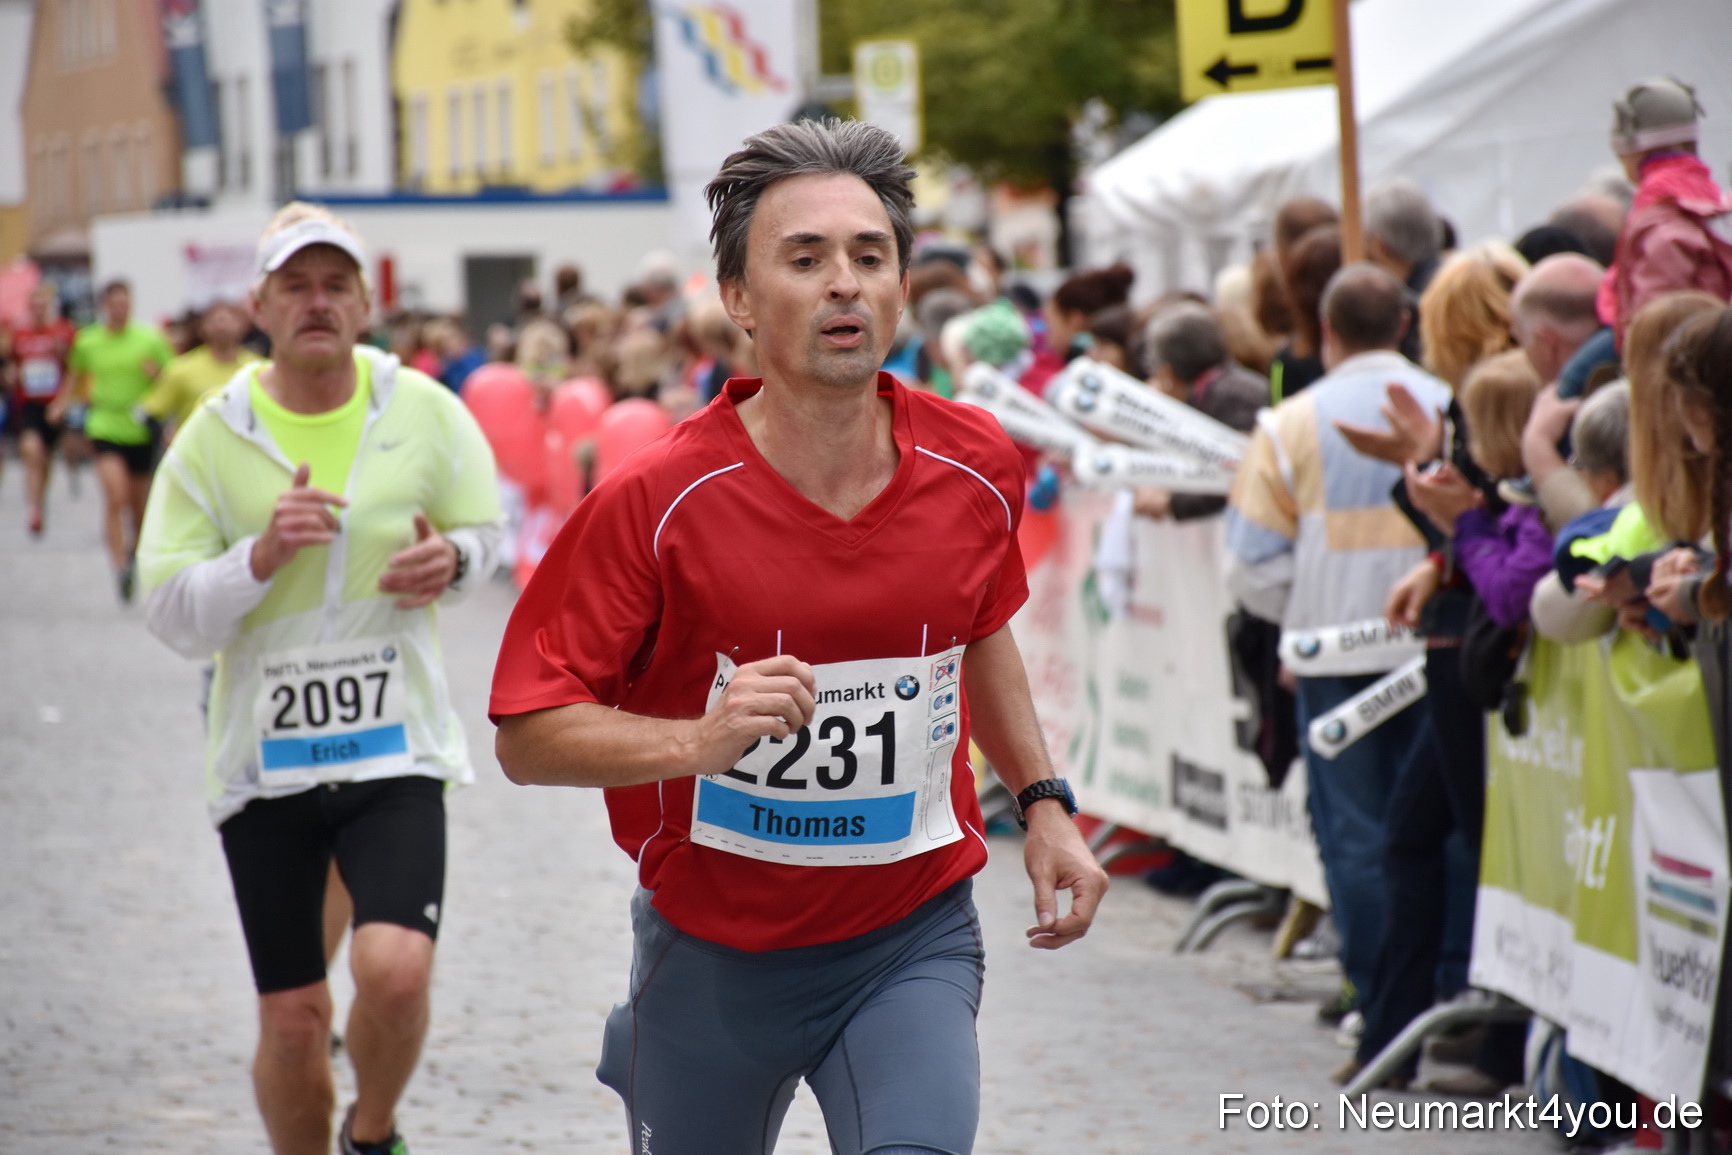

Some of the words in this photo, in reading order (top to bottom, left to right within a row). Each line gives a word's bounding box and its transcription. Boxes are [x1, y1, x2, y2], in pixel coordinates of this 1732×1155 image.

[306, 652, 377, 673] Neumarkt
[271, 671, 390, 730] 2097
[1355, 674, 1417, 724] BMW
[311, 740, 361, 764] Erich
[749, 803, 866, 838] Thomas
